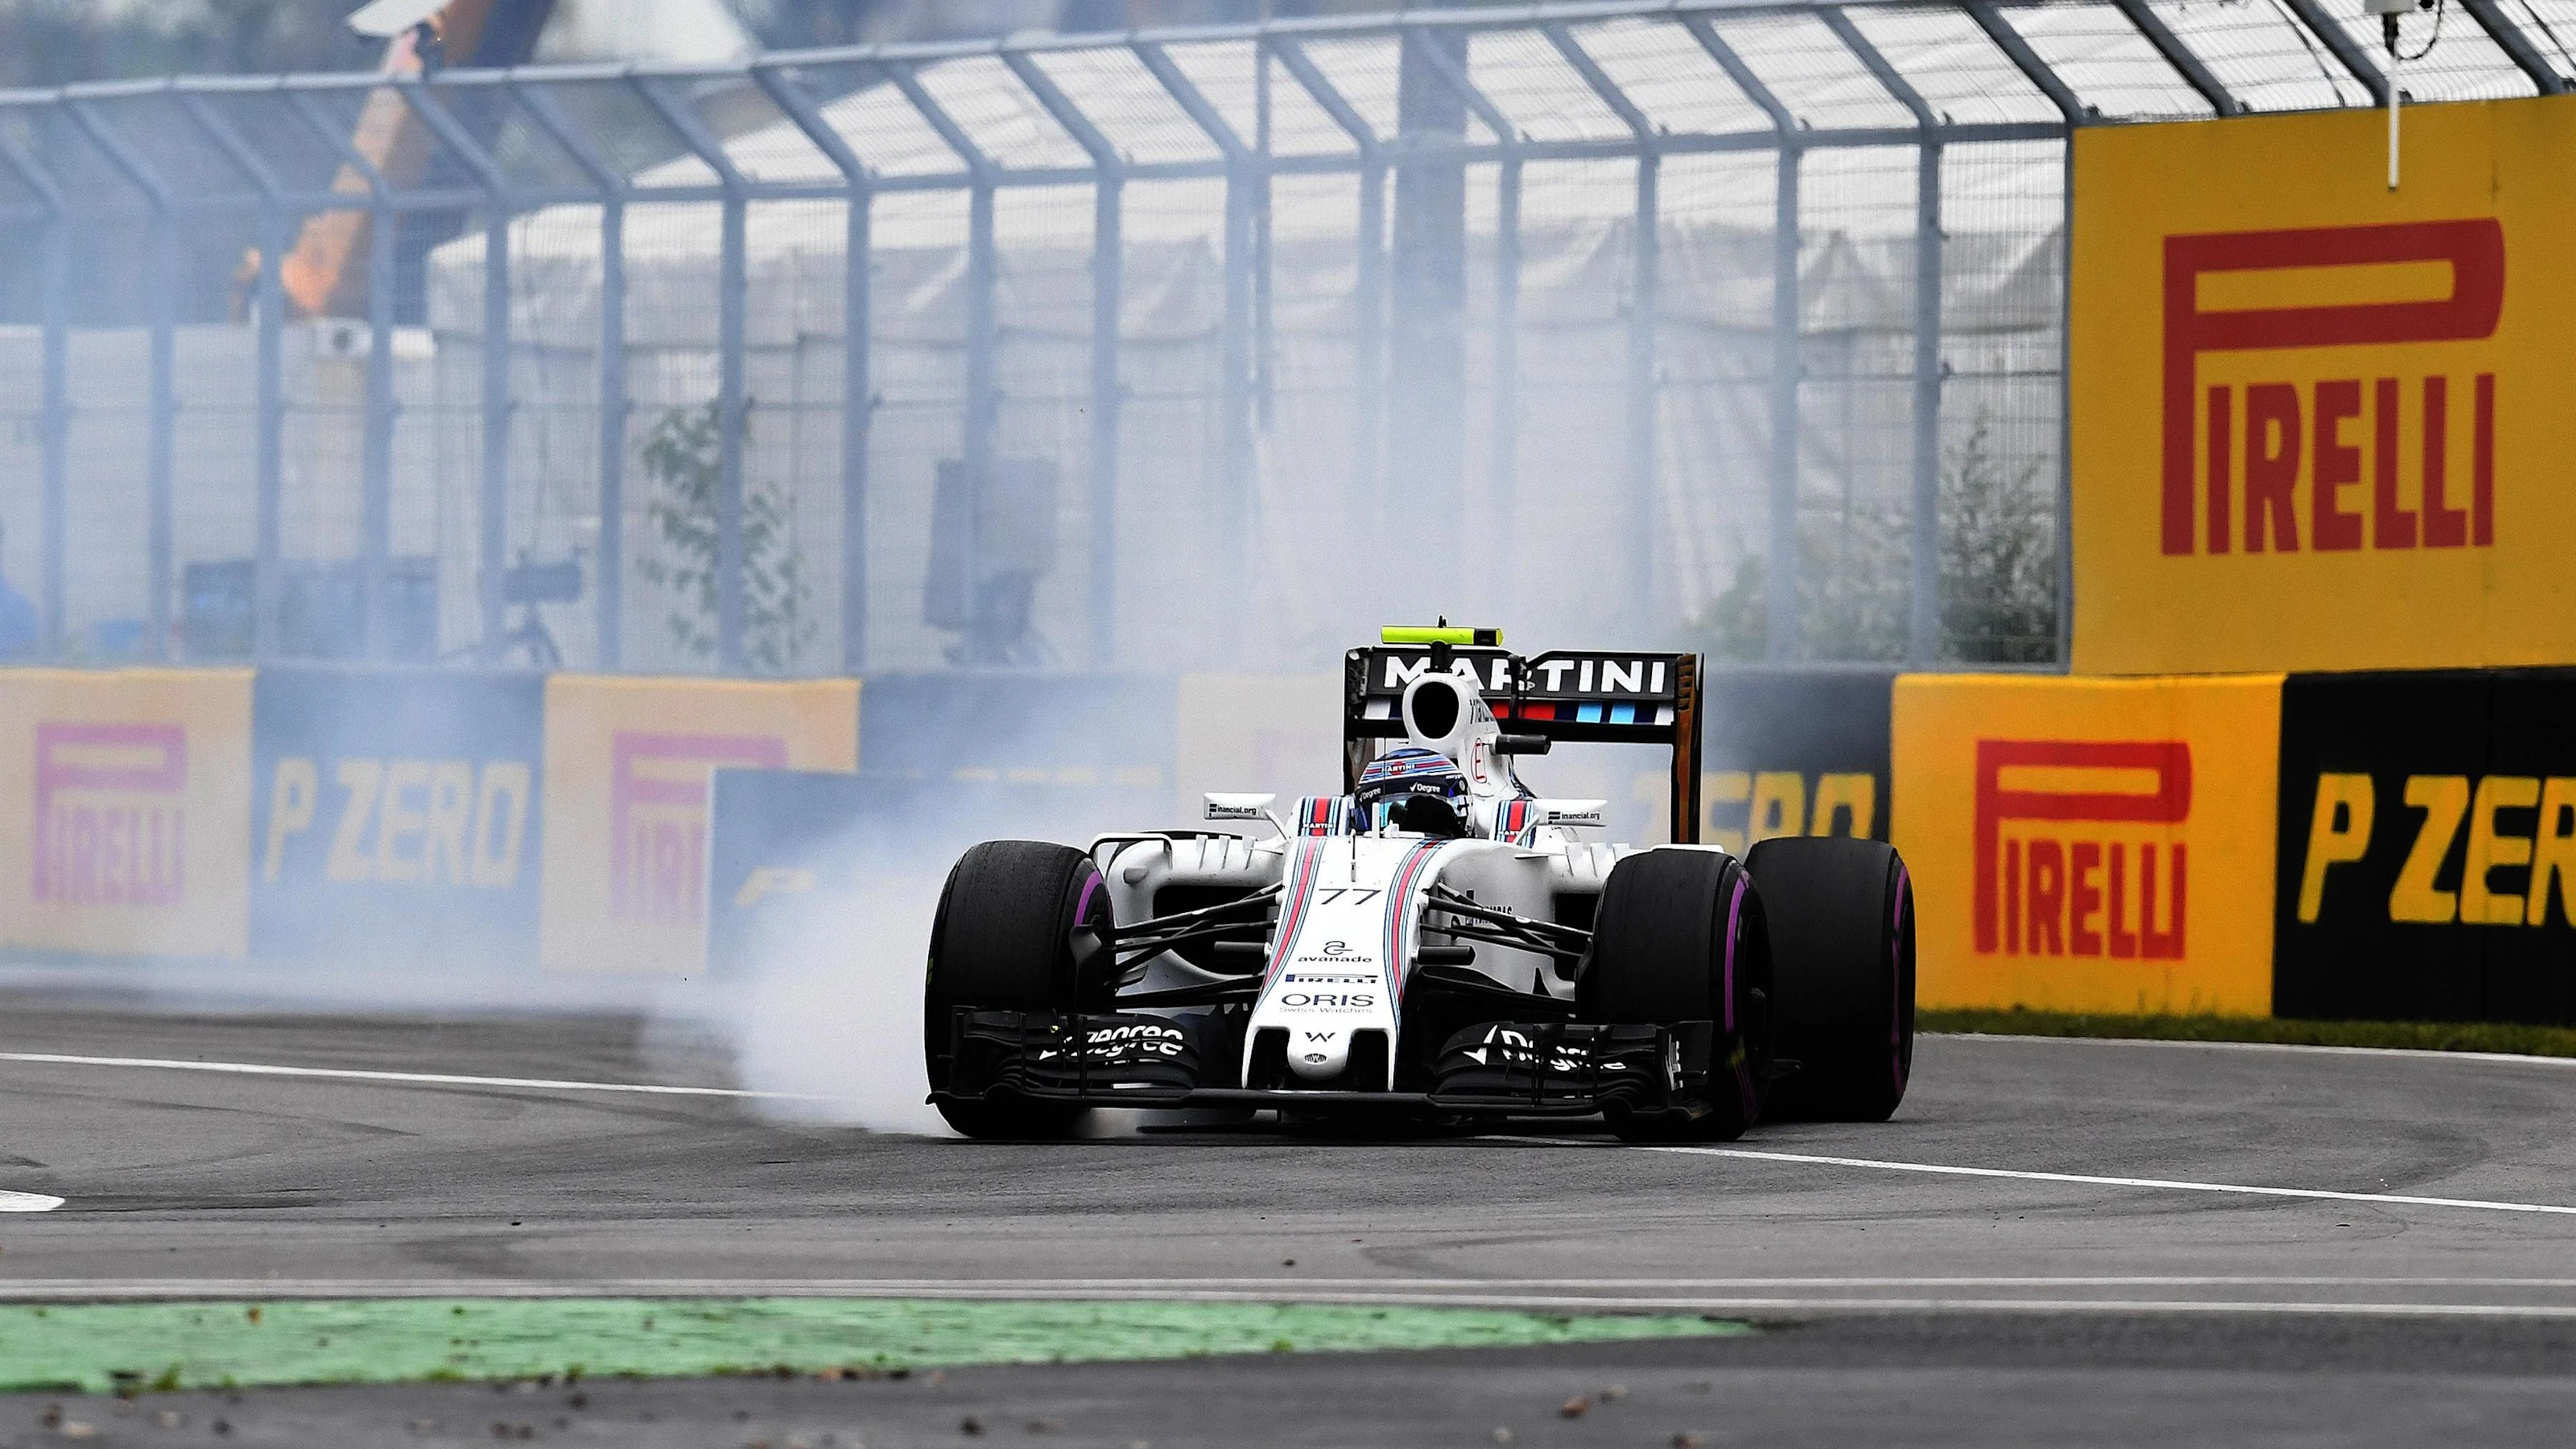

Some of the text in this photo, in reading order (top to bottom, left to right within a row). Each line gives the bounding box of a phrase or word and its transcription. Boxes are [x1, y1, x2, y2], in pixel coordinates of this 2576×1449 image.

[2161, 217, 2506, 555] PIRELLI
[32, 722, 187, 904] PIRELLI
[266, 758, 530, 886] P ZERO
[1381, 764, 1416, 773] MARTINI
[1417, 782, 1441, 794] Degree
[1319, 889, 1381, 905] 77
[1971, 738, 2192, 961] PIRELLI
[2297, 772, 2376, 923] P
[1282, 993, 1374, 1006] ORIS
